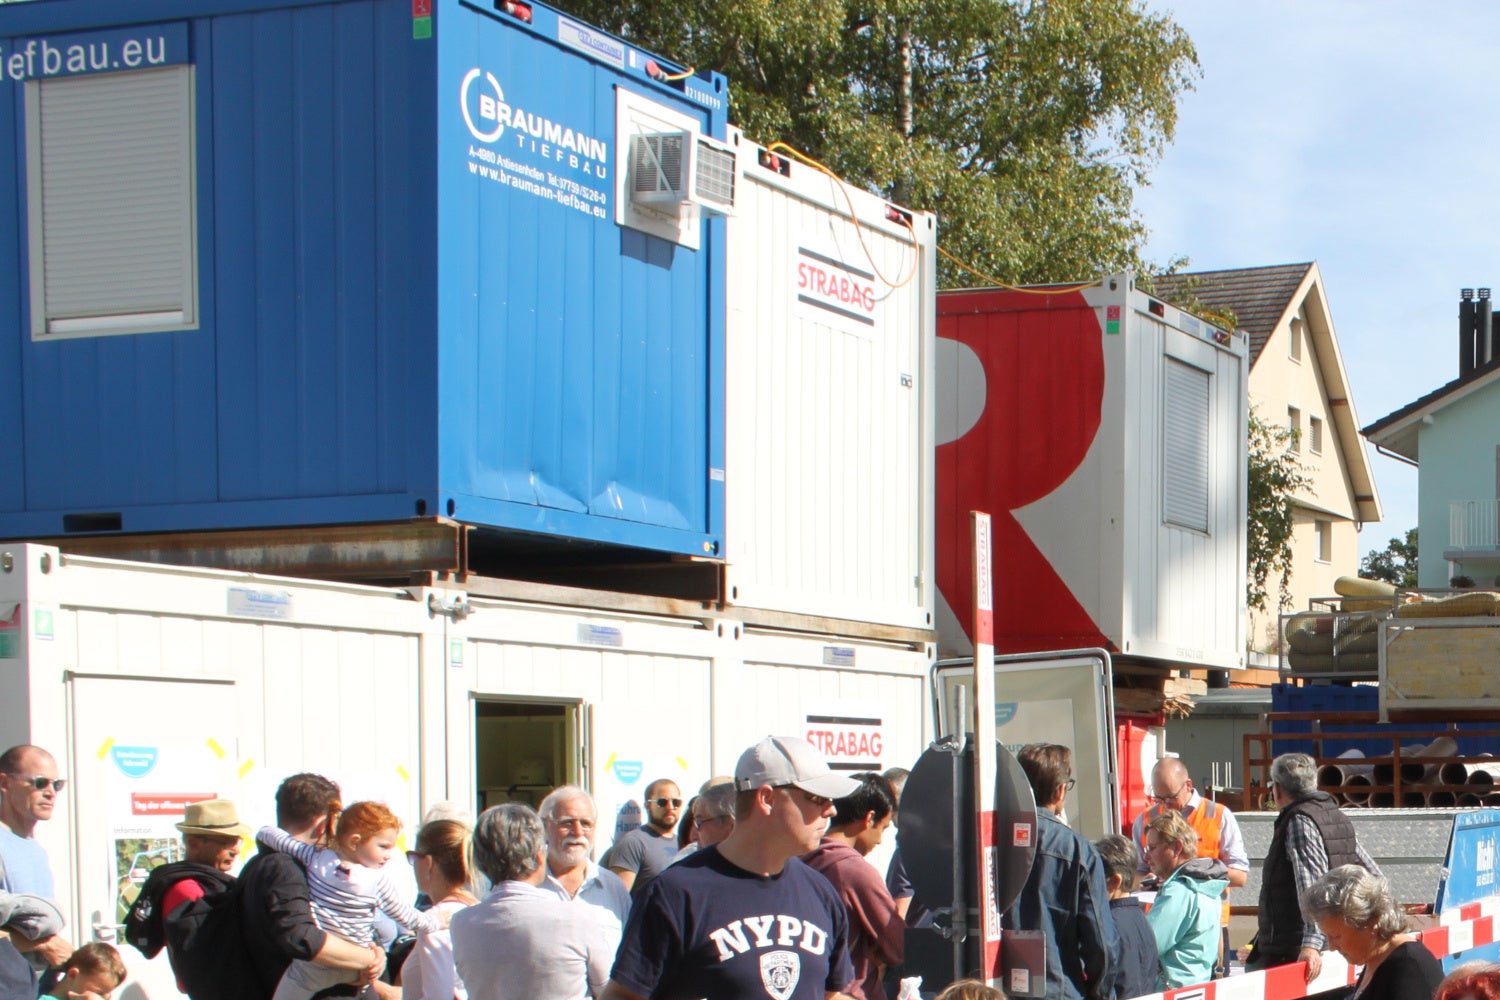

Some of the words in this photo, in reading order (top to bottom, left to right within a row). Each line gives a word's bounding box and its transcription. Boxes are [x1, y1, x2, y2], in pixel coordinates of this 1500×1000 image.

[480, 94, 606, 164] BRAUMANN
[517, 134, 606, 179] TIEFBAU
[798, 262, 875, 312] STRABAG
[709, 915, 828, 962] NYPD
